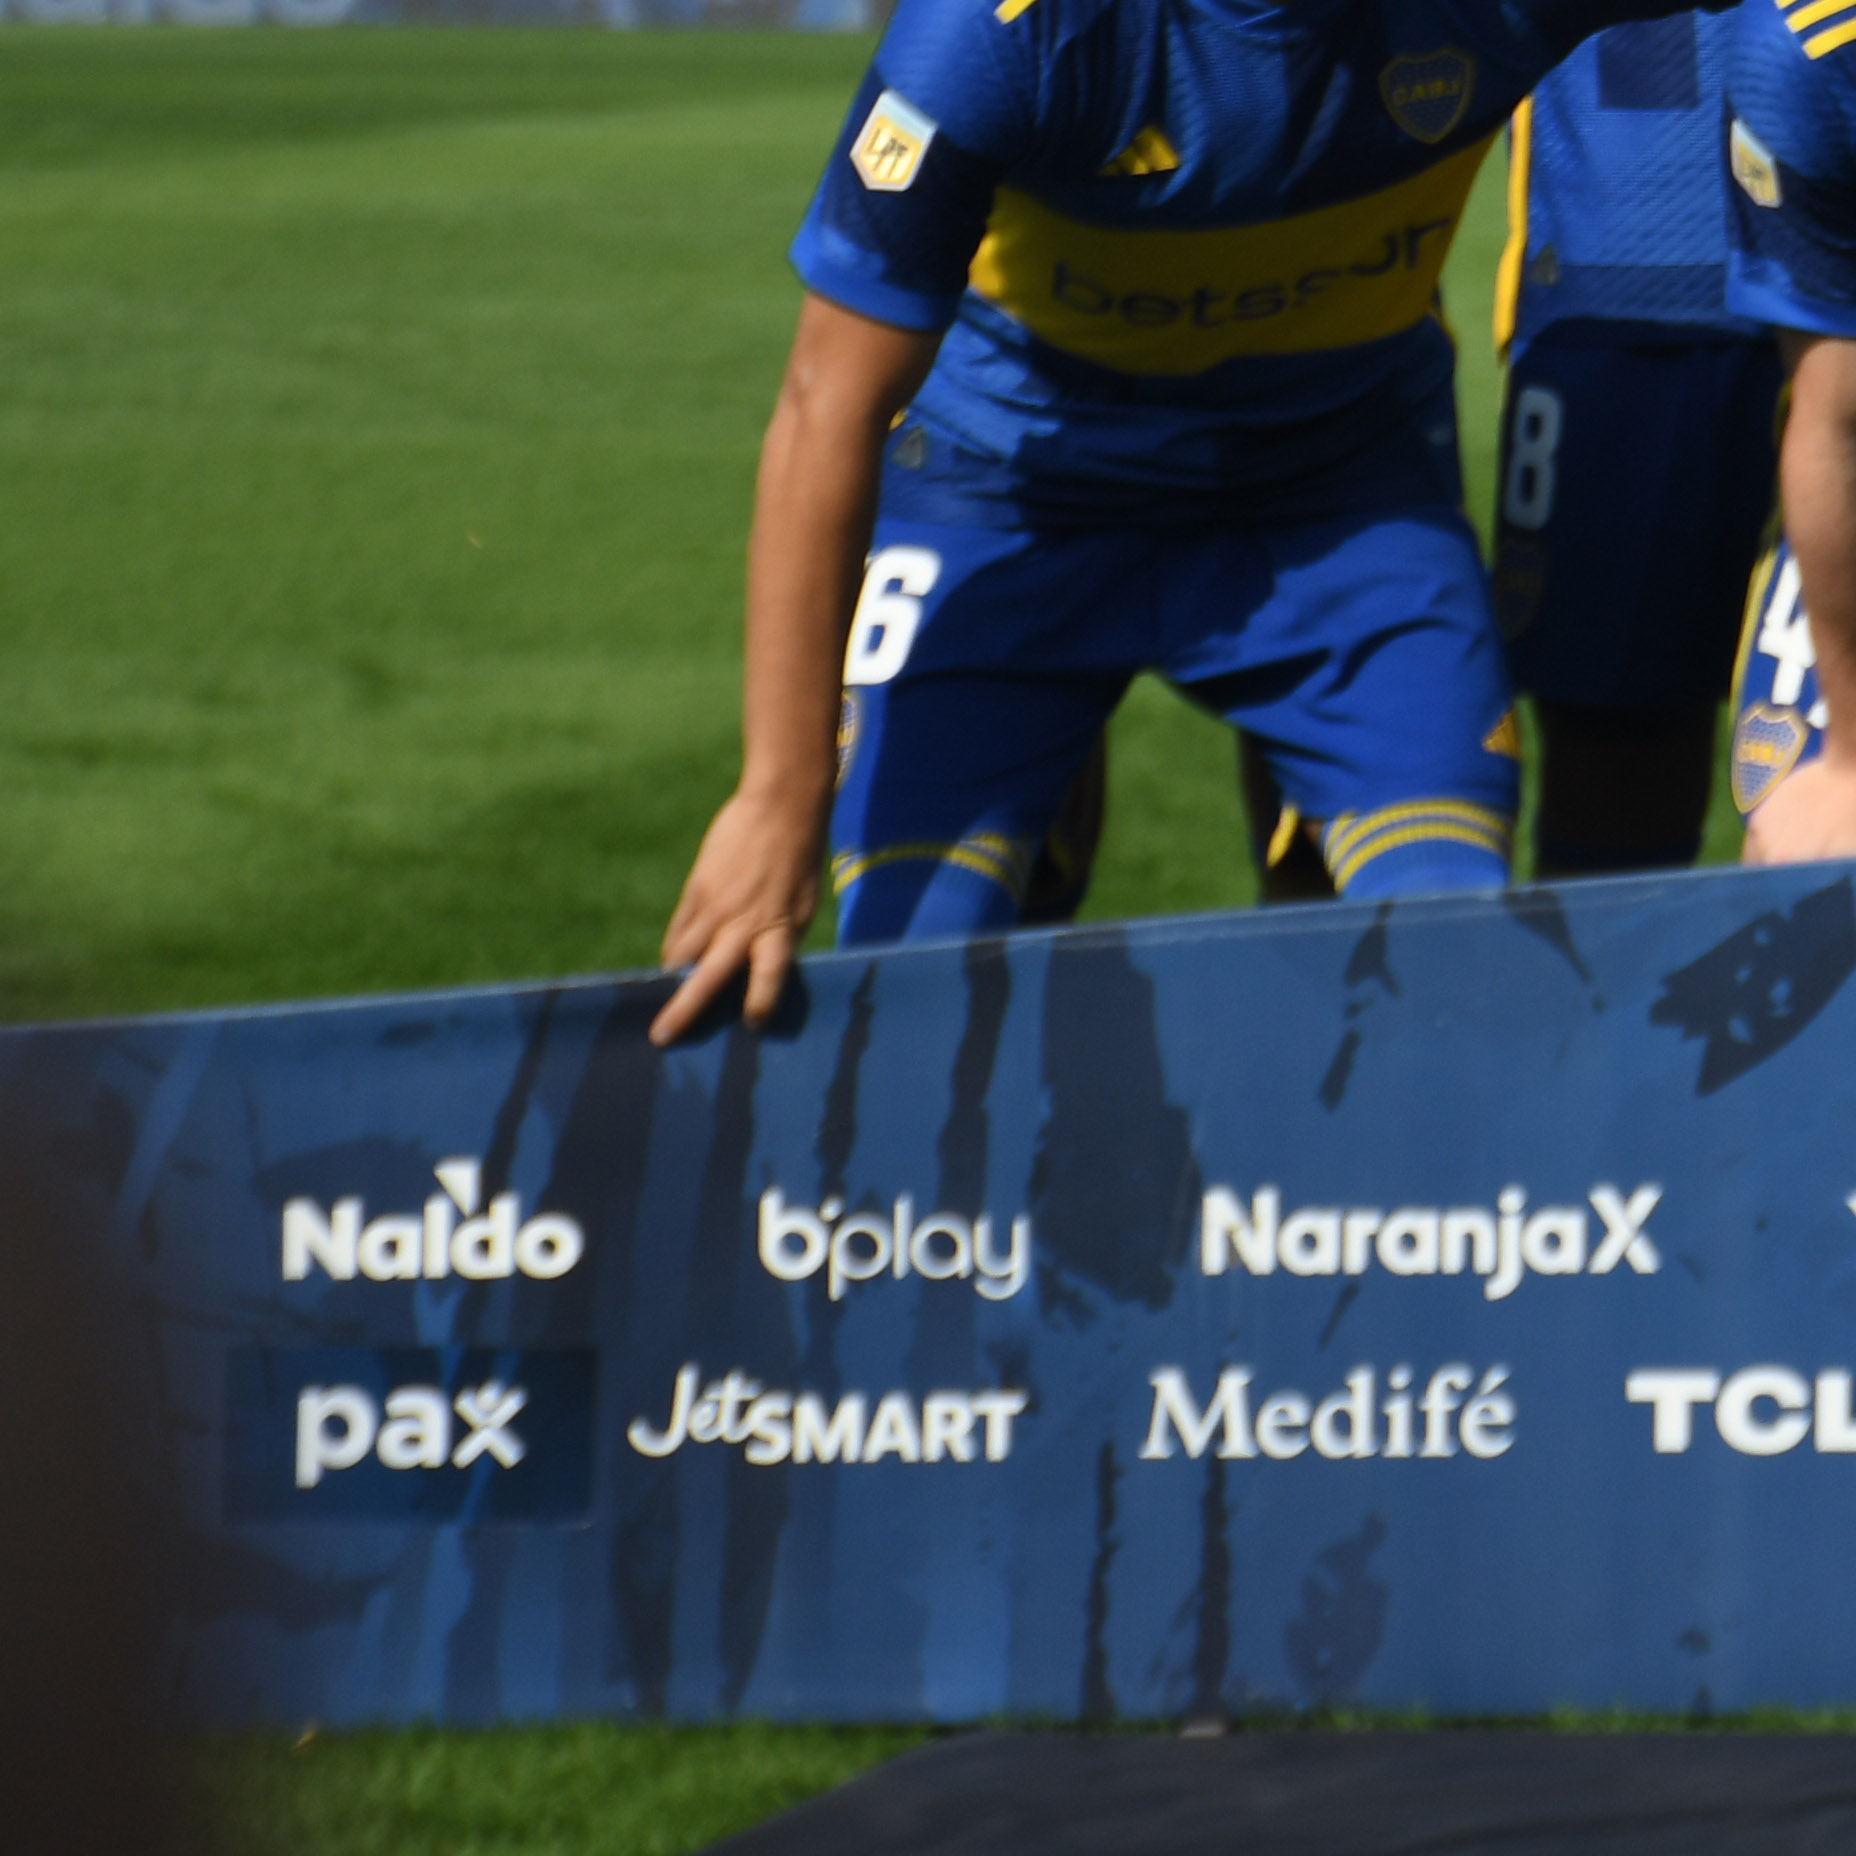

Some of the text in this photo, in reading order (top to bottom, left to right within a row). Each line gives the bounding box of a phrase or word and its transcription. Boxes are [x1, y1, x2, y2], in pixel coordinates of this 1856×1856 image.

[1506, 384, 1563, 531] 8
[843, 545, 941, 687] 6
[282, 1189, 584, 1281] Naldo
[295, 1377, 528, 1489] pax
[627, 1362, 1030, 1467] JetSMART
[1138, 1362, 1518, 1460] Medifé
